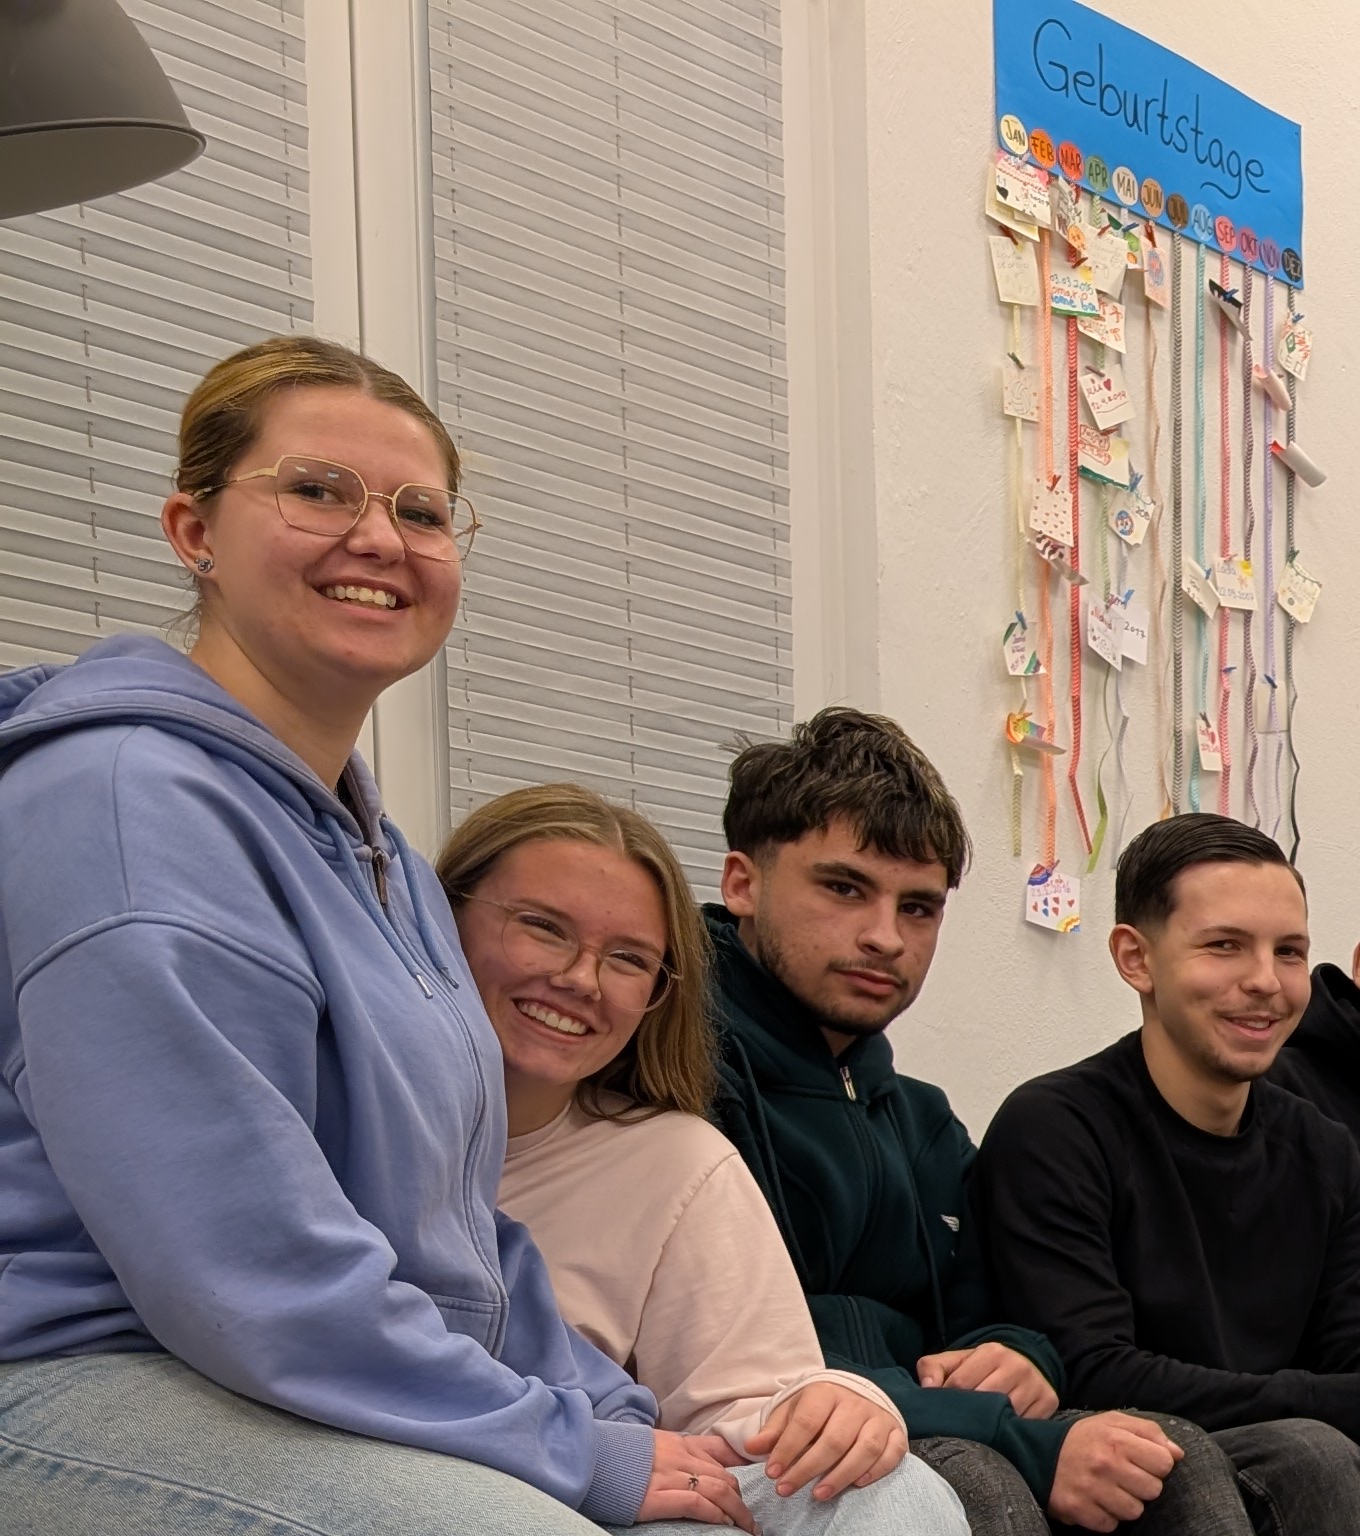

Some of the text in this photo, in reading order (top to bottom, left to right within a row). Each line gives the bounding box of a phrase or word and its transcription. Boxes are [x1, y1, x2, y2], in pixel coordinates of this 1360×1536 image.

[1004, 119, 1025, 147] JAN
[1030, 135, 1055, 162] FEB
[1088, 161, 1109, 189] APR
[1116, 171, 1137, 200] MAI
[1143, 184, 1163, 210] JUN
[1193, 208, 1214, 235] AUG
[1217, 221, 1236, 245] SEP
[1033, 18, 1271, 200] Geburtstage
